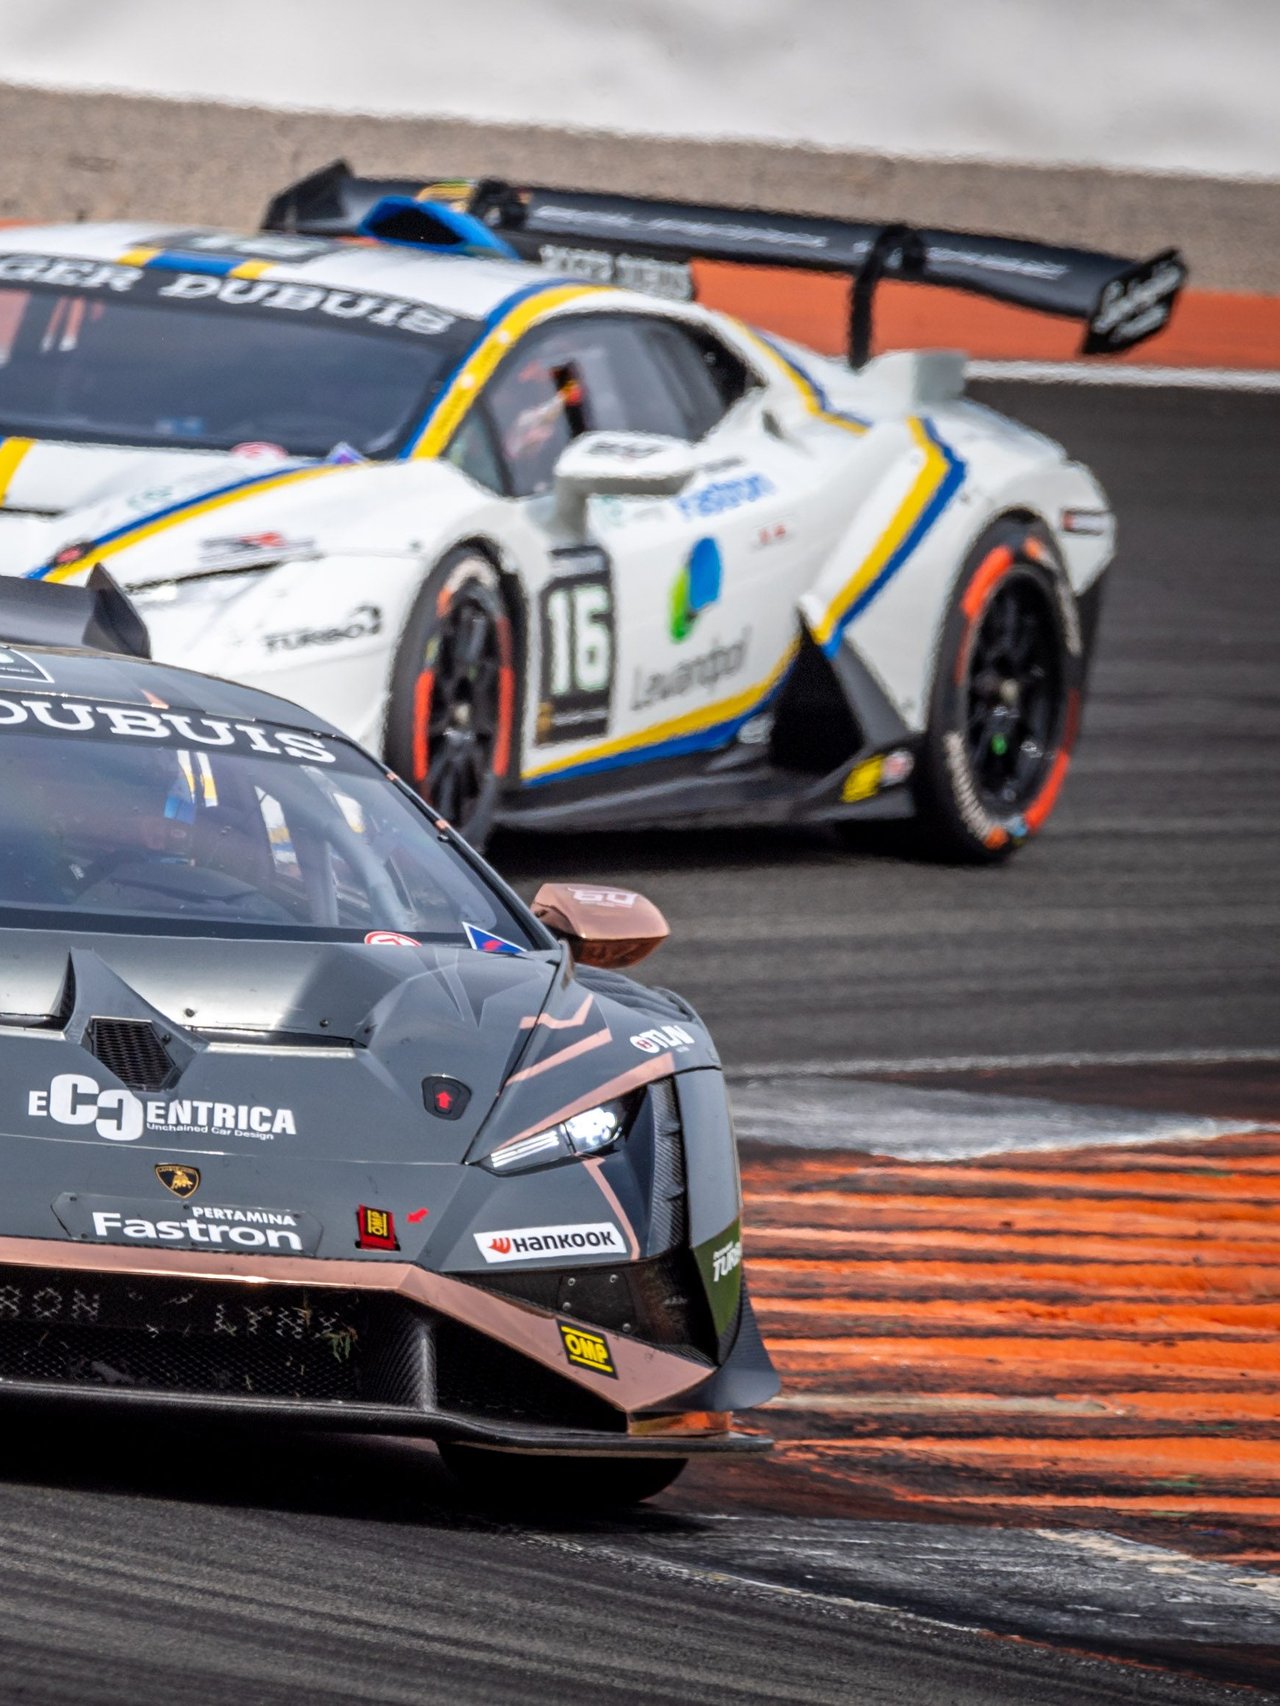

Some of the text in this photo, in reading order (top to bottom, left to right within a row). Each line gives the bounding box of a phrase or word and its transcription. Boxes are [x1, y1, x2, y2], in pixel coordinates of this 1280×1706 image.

[158, 273, 457, 335] DUBUIS
[547, 583, 610, 696] 16
[146, 1122, 275, 1141] Unchained Car Design
[92, 1212, 303, 1250] Fastron
[191, 1206, 298, 1226] PERTAMINA
[366, 1210, 389, 1236] OMP
[564, 1331, 608, 1364] OMP
